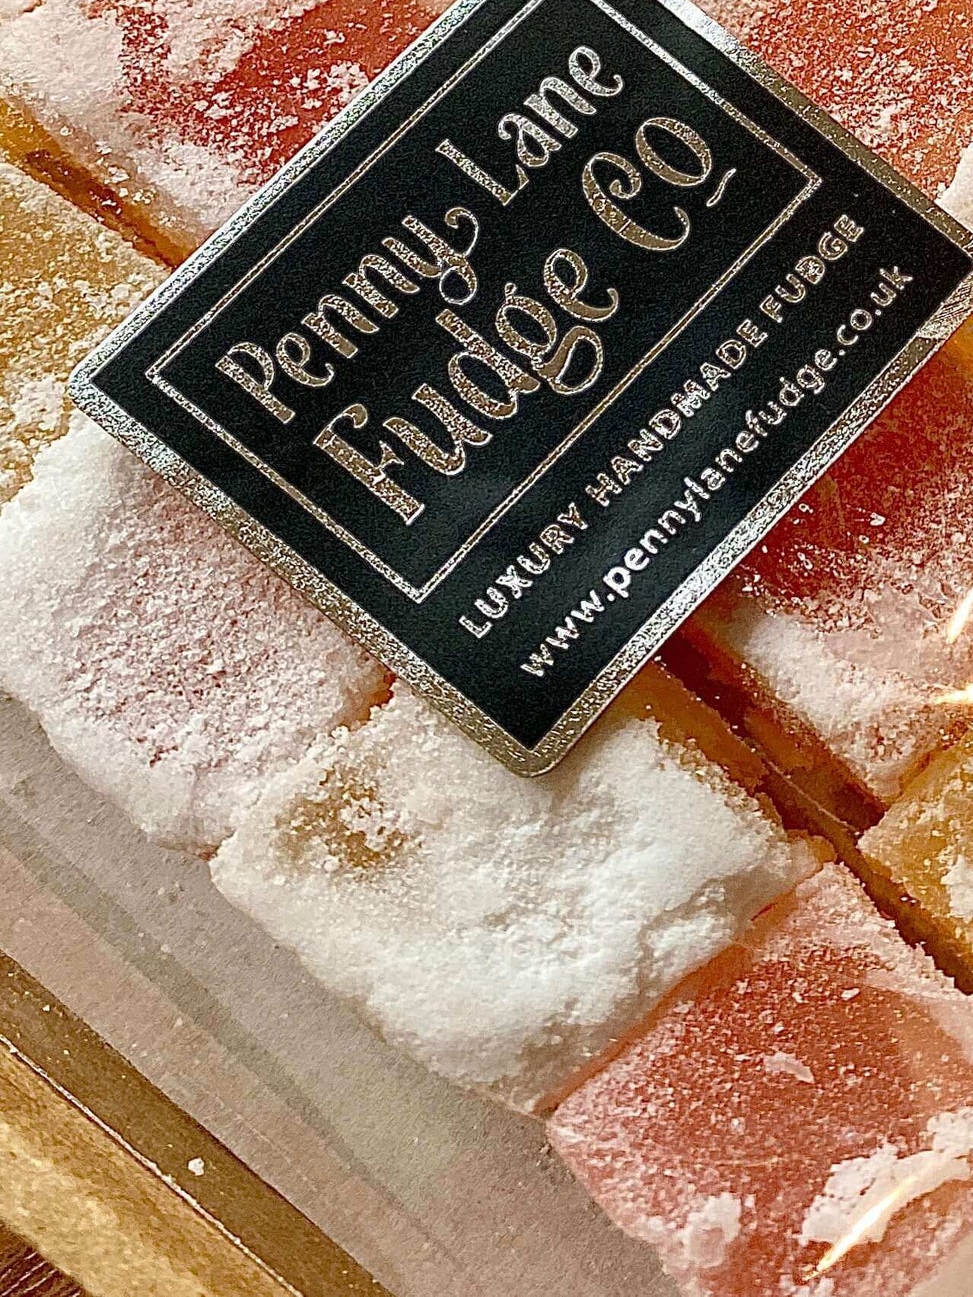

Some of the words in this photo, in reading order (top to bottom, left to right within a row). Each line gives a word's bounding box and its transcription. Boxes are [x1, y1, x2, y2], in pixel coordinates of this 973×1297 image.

[215, 207, 479, 423] Penny
[435, 46, 623, 205] Lane
[313, 248, 619, 525] Fudge
[458, 503, 588, 638] LUXURY
[585, 320, 768, 507] HANDMADE
[760, 215, 865, 323] FUDGE
[520, 266, 913, 677] www.pennylanefudge.co.uk
